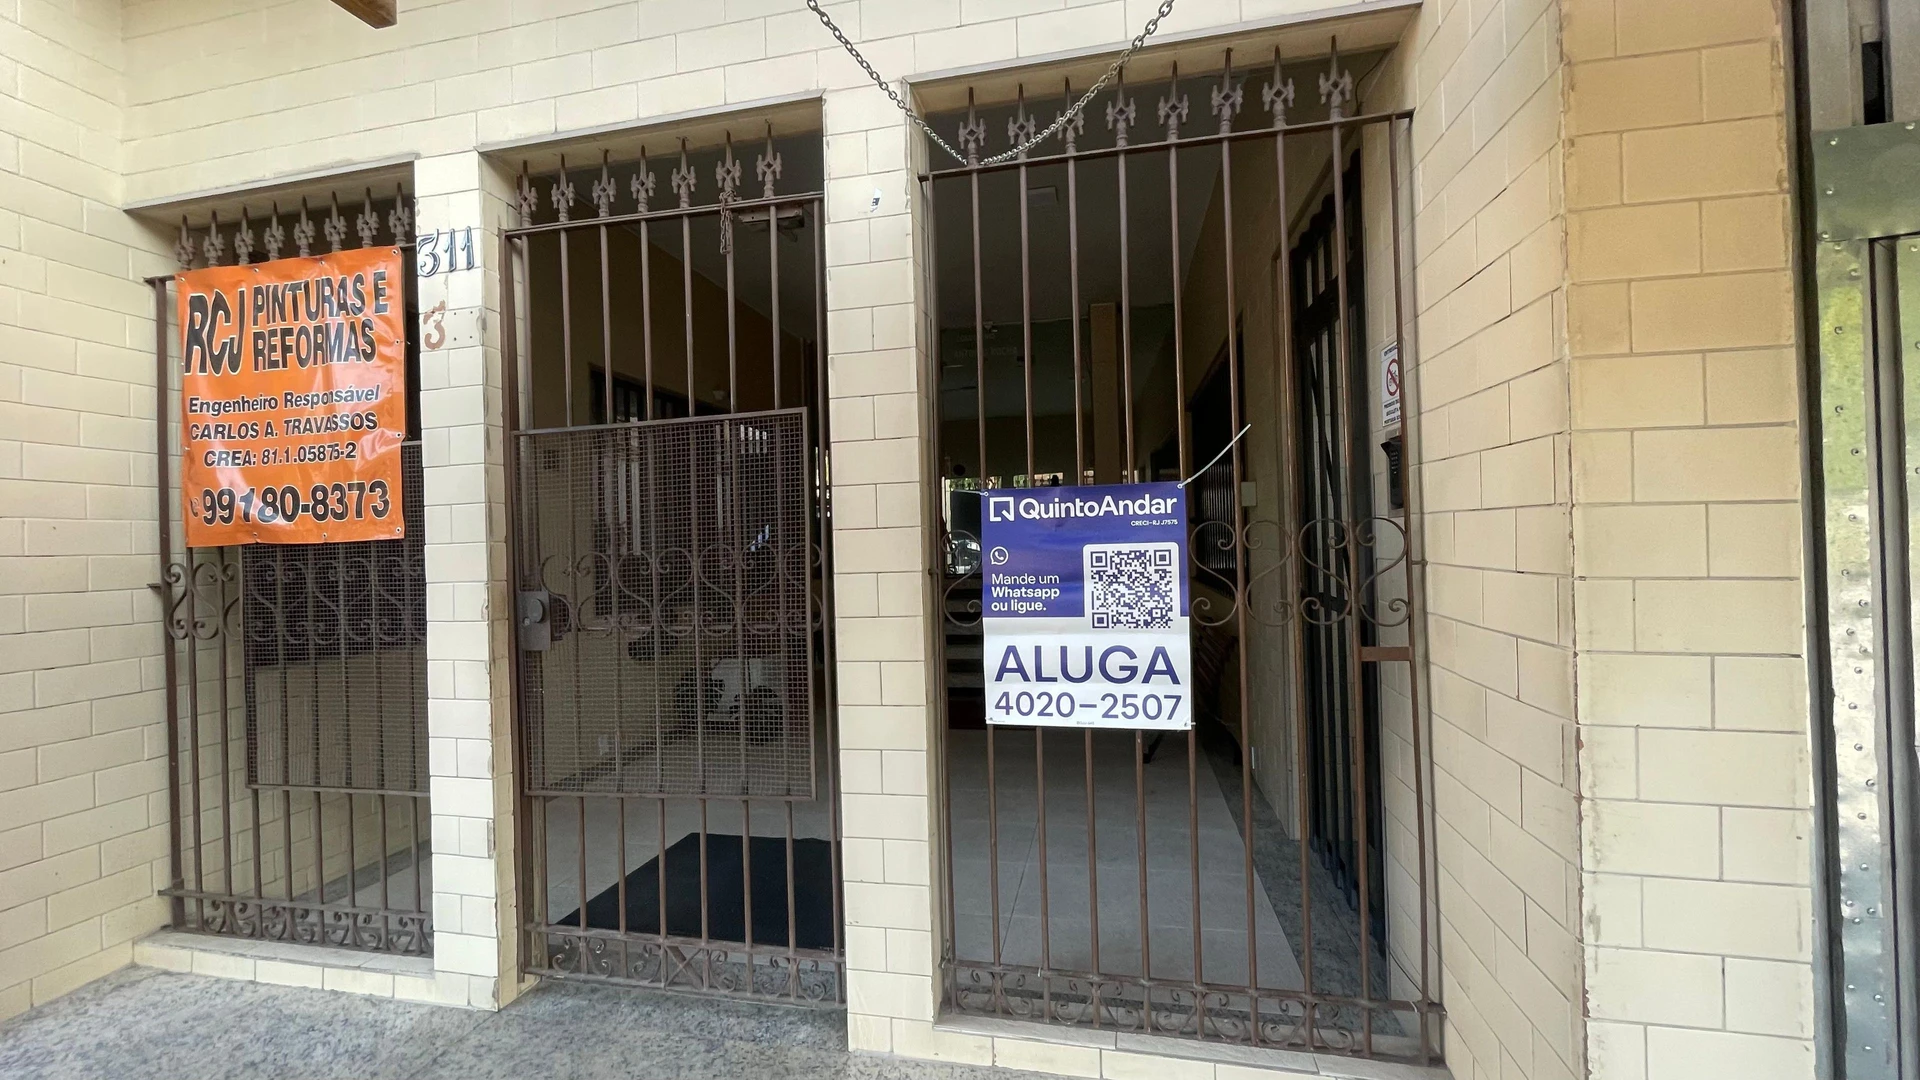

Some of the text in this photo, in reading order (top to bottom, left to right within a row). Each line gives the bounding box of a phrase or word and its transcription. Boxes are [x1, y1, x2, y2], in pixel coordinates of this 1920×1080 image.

[417, 226, 474, 277] 311
[252, 270, 389, 327] PINTURAS E
[184, 287, 246, 377] RCJ
[252, 317, 377, 372] REFORMAS
[188, 384, 381, 418] Engenheiro Responsável
[190, 412, 378, 441] CARLOS A. TRAVASSOS
[204, 448, 257, 467] CREA:
[202, 479, 391, 526] 99180-8373
[1018, 493, 1178, 521] QuintoAndar
[991, 572, 1060, 585] Mande um
[991, 585, 1060, 600] Whatsapp
[991, 599, 1047, 614] ou ligue.
[994, 644, 1181, 685] ALUGA
[994, 691, 1182, 721] 4020-2507
